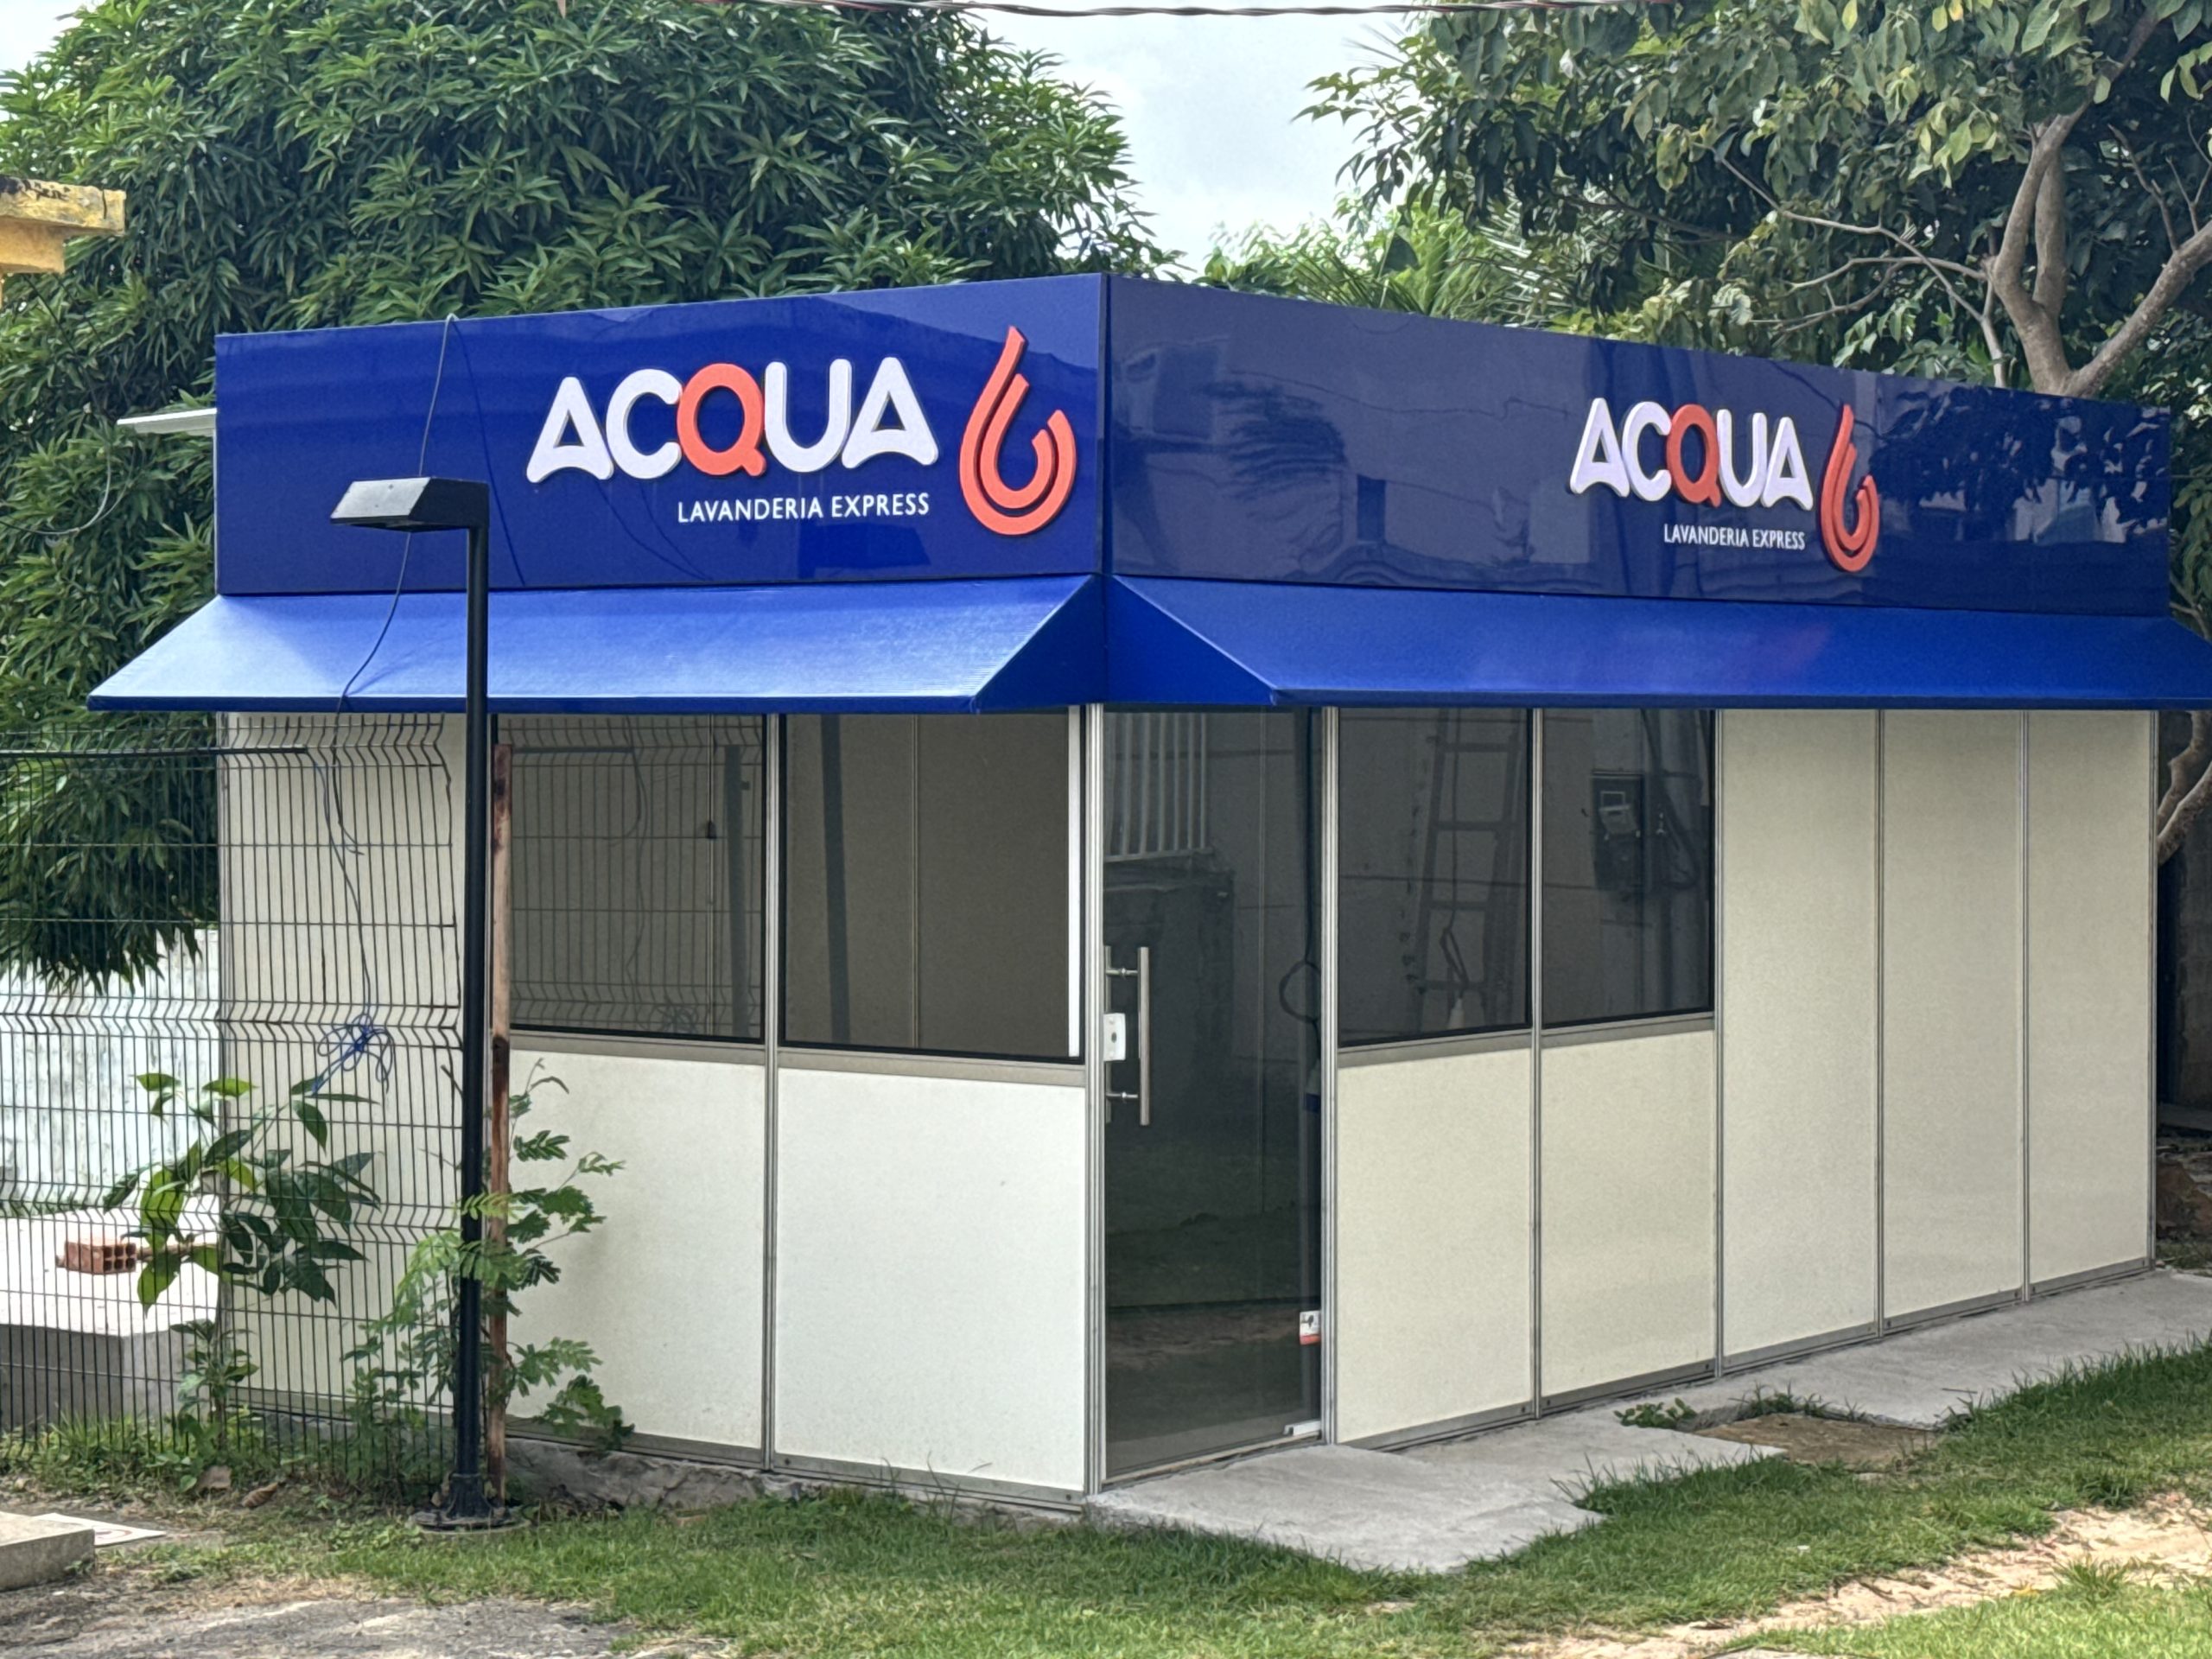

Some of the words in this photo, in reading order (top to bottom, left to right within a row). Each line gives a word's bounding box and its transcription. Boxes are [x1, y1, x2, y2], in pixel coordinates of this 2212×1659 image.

[526, 356, 939, 483] ACQUA
[1569, 397, 1814, 511] ACQUA
[677, 497, 823, 523] LAVANDERIA
[831, 493, 930, 518] EXPRESS
[1664, 524, 1749, 548] LAVANDERIA
[1752, 529, 1806, 550] EXPRESS
